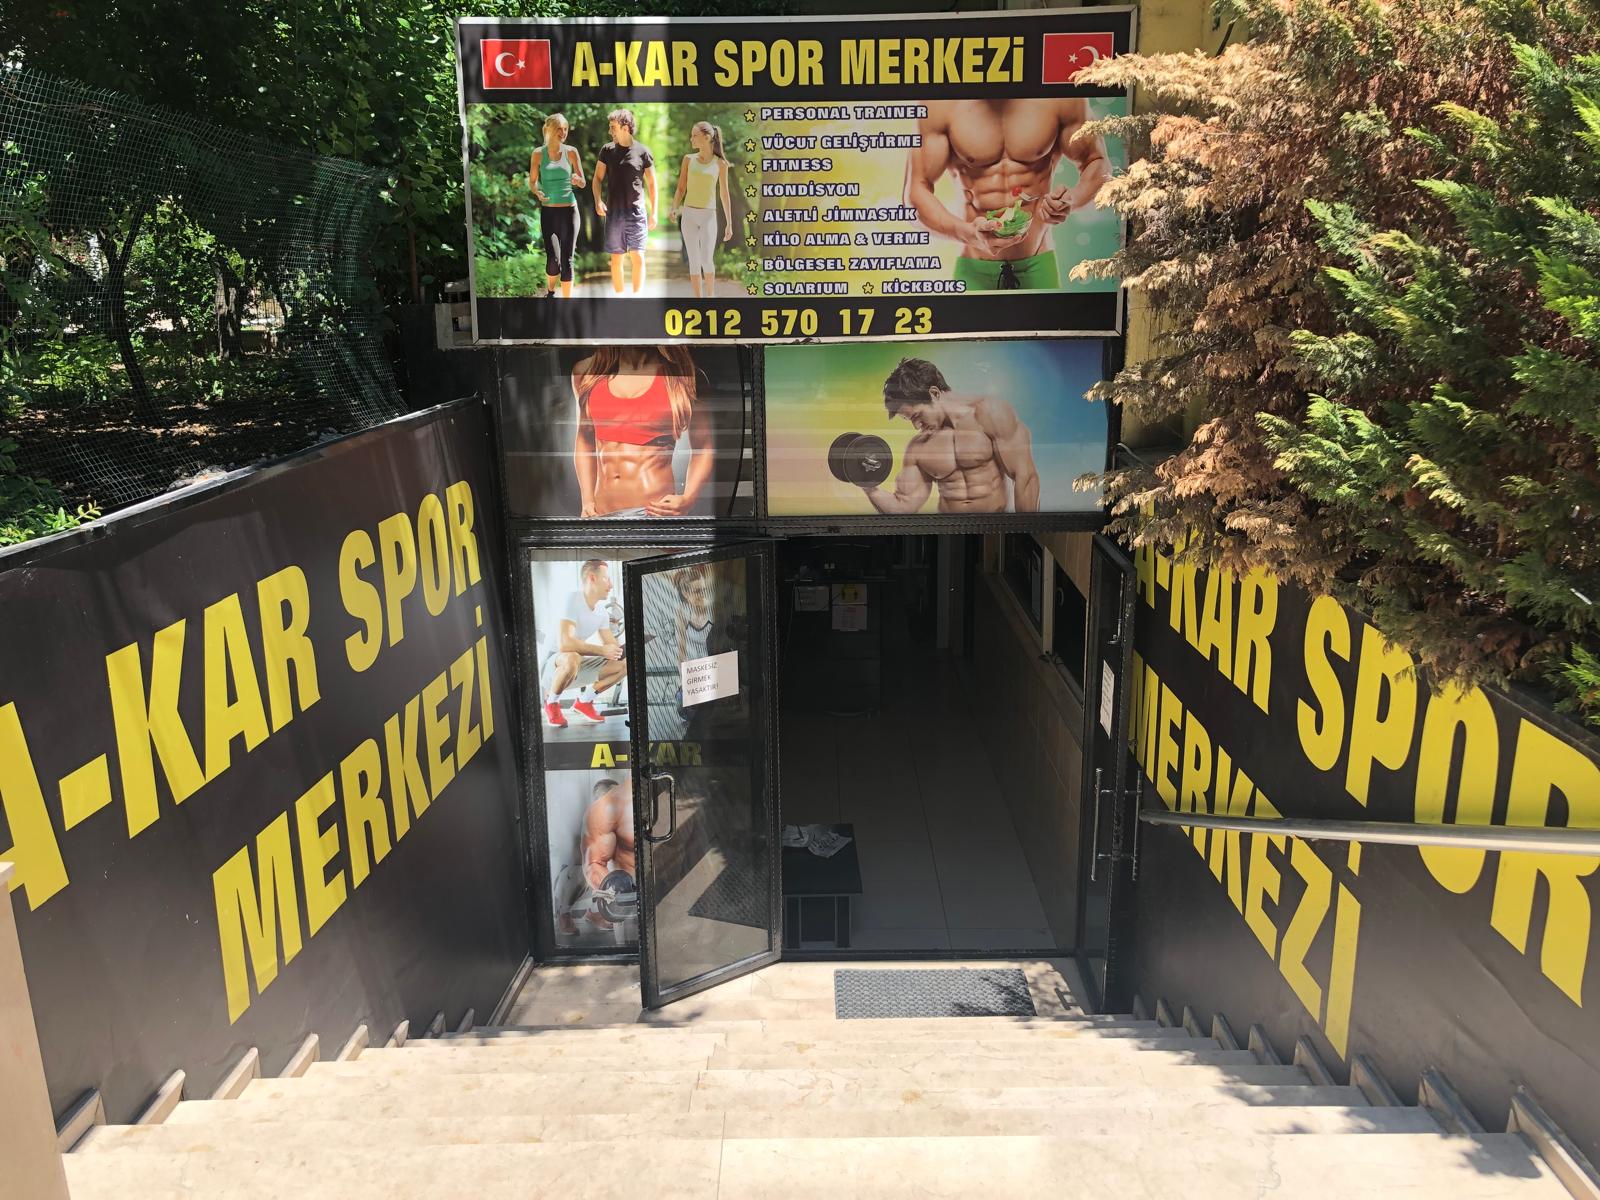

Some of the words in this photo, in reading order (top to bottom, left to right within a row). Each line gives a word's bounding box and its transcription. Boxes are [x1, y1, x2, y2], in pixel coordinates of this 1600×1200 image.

[571, 41, 698, 87] A-KAR
[714, 39, 824, 87] SPOR
[761, 106, 849, 120] PERSONAL
[854, 106, 928, 119] TRAINER
[762, 133, 817, 150] VÜCUT
[821, 132, 922, 152] GELİŞTİRME
[762, 158, 832, 171] FITNESS
[762, 180, 860, 197] KONDİSYON
[763, 206, 818, 222] ALETLİ
[822, 205, 917, 221] JİMNASTİK
[763, 231, 801, 246] KİLO
[804, 233, 850, 246] ALMA
[854, 233, 868, 246] &
[872, 232, 929, 245] VERME
[763, 256, 845, 271] BÖLGESEL
[849, 257, 941, 270] ZAYIFLAMA
[764, 282, 848, 295] SOLARIUM
[882, 278, 966, 294] KİCKBOKS
[665, 308, 741, 336] 0212
[761, 308, 818, 336] 570
[839, 308, 875, 335] 17
[895, 307, 933, 334] 23
[338, 480, 481, 672] SPOR
[1297, 595, 1600, 1008] SPOR
[212, 605, 494, 1025] MERKEZİ
